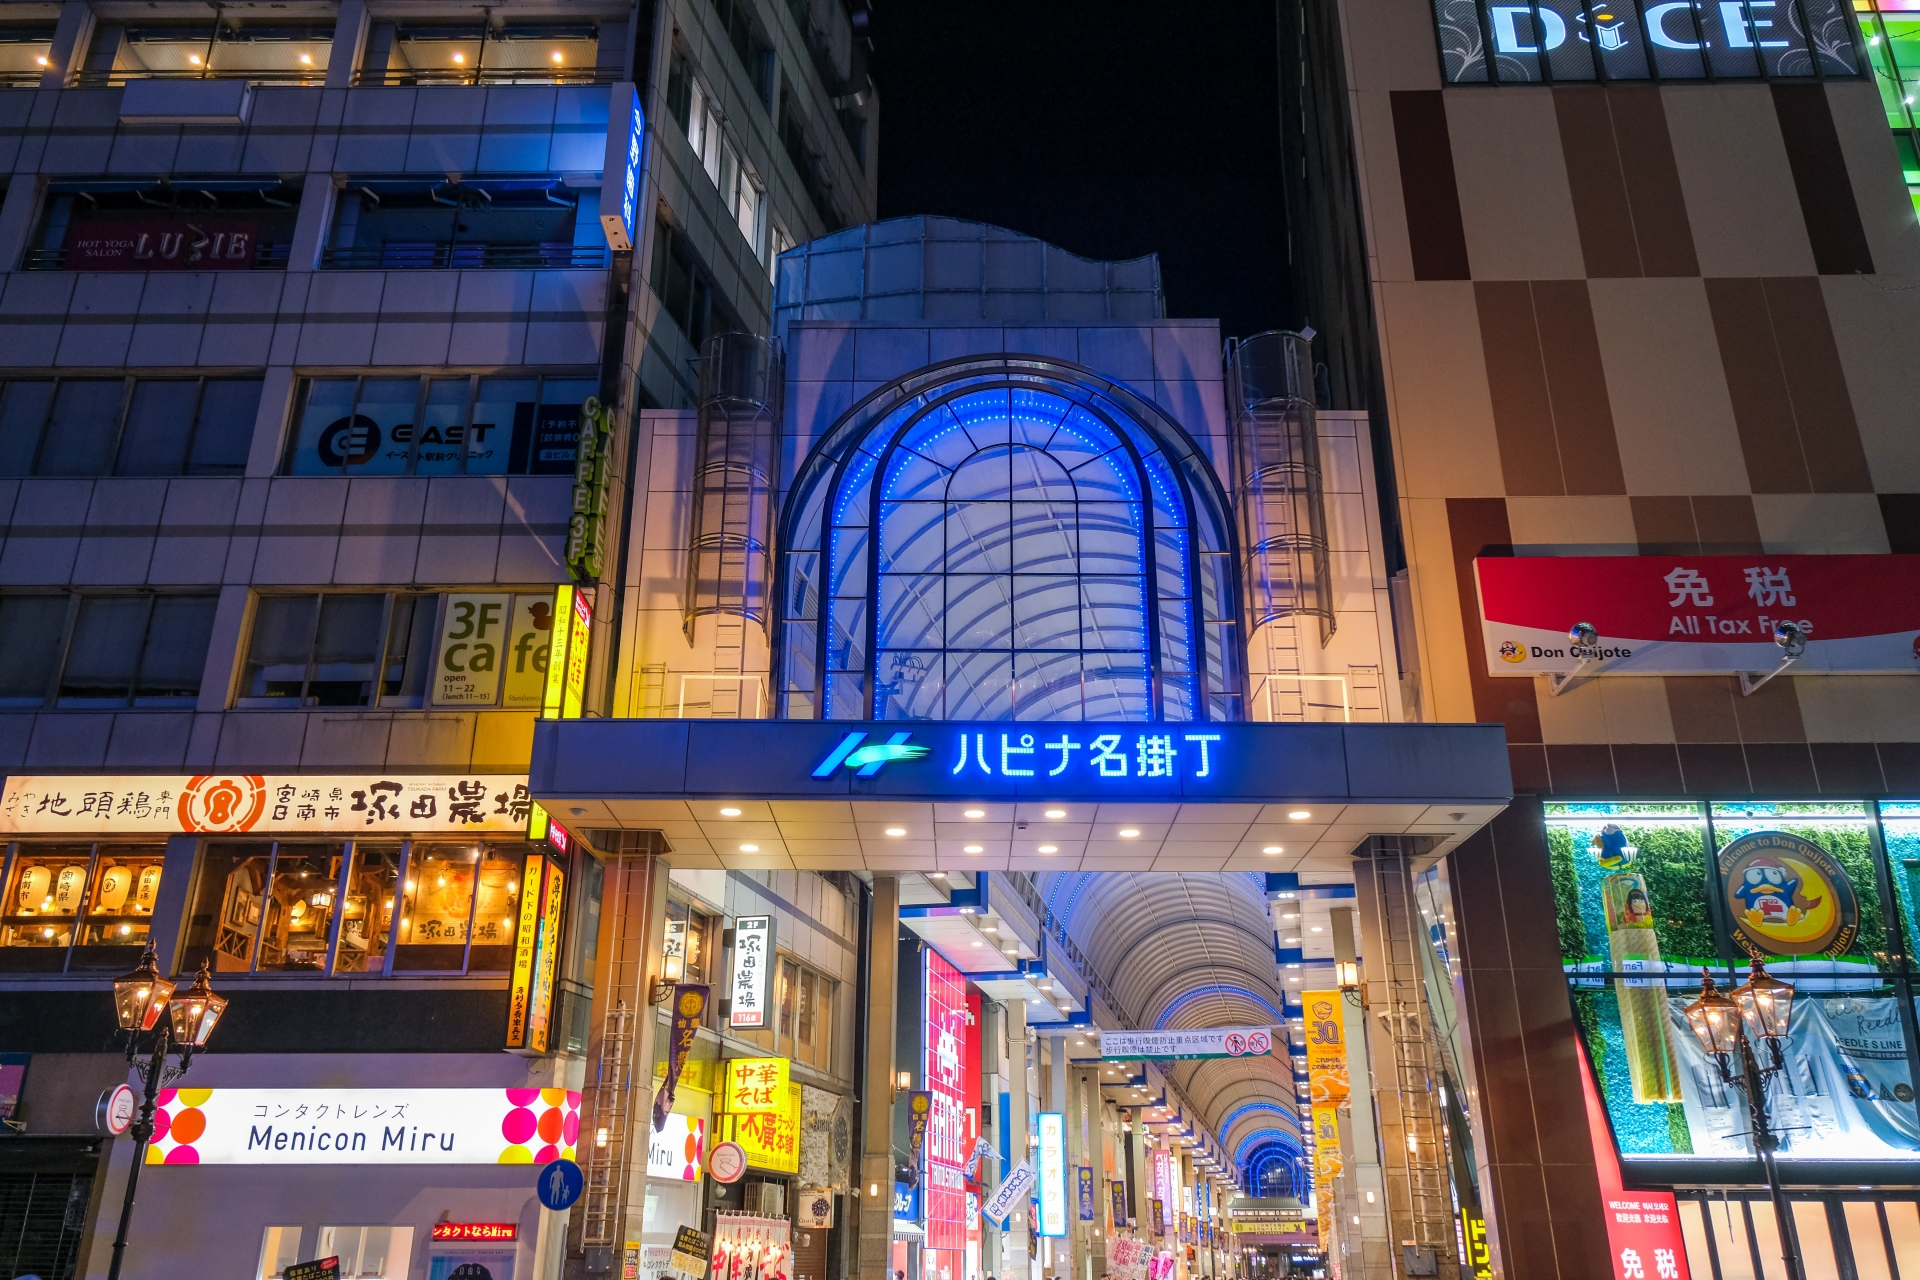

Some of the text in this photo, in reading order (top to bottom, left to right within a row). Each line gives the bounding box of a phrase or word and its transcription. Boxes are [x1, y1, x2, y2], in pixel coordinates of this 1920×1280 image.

[77, 240, 134, 248] HOT YOGA
[85, 249, 122, 257] SALON
[391, 423, 496, 445] EAST
[1663, 566, 1797, 608] 免税
[448, 601, 502, 640] 3F
[1669, 615, 1699, 635] All
[1709, 615, 1749, 635] Tax
[1531, 646, 1564, 659] Don
[444, 674, 466, 683] open
[952, 733, 1221, 778] ハピナ名掛丁
[272, 804, 341, 822] 日南市
[350, 780, 530, 825] 塚田農場
[1719, 836, 1836, 877] Welcome to Don Quijote
[518, 866, 538, 969] ガード下の昭和酒場
[746, 921, 759, 929] 2F
[738, 934, 761, 1009] 塚田農場
[1105, 1034, 1224, 1046] ここは歩行喫煙防止重点区域です
[1105, 1045, 1177, 1054] 歩行喫煙は禁止です
[1880, 1040, 1903, 1049] LINE
[735, 1063, 779, 1086] 中華
[734, 1084, 778, 1106] そば
[253, 1102, 410, 1121] コンタクトレンズ
[247, 1125, 455, 1152] Menicon Miru
[1046, 1124, 1059, 1225] カラオケ館
[1608, 1201, 1641, 1210] WELCOME
[433, 1225, 512, 1238] ンタクトならMiru
[1620, 1247, 1679, 1279] 免税
